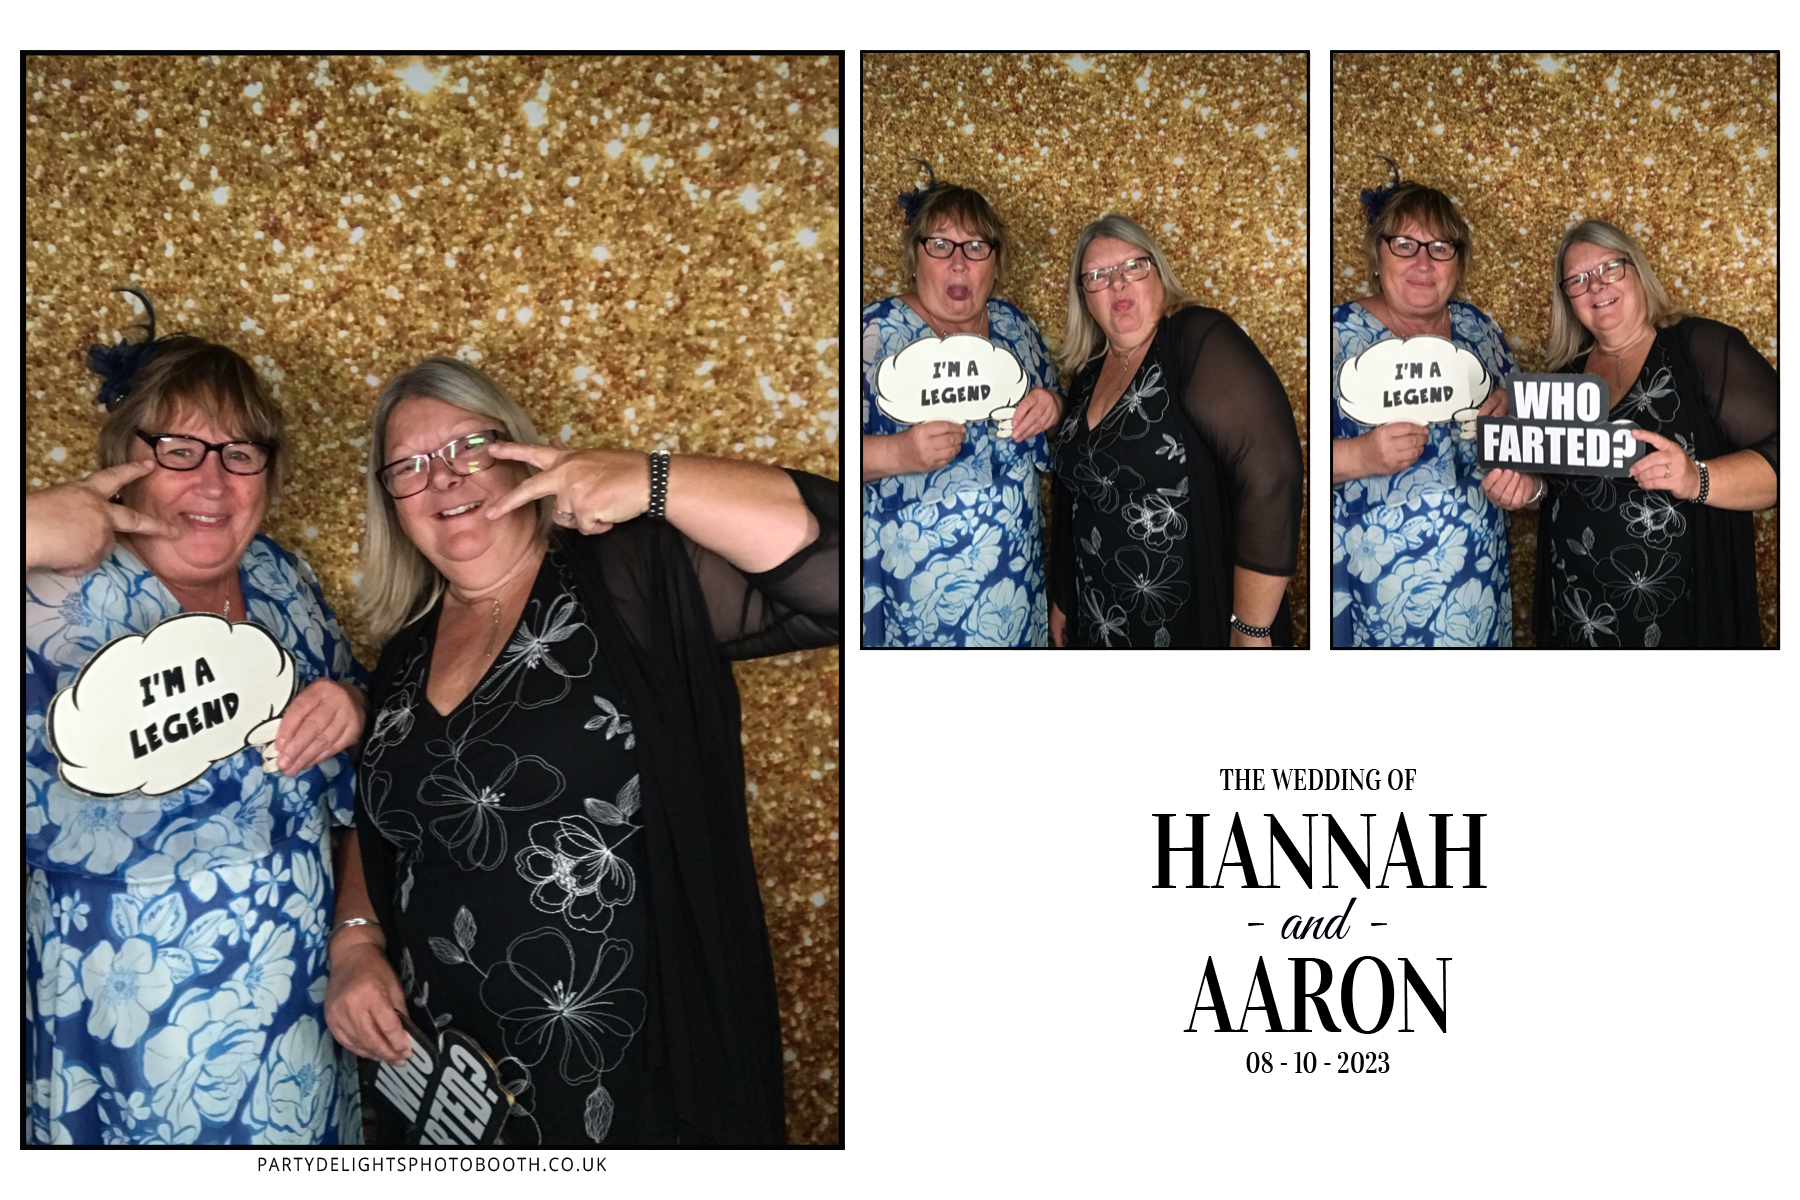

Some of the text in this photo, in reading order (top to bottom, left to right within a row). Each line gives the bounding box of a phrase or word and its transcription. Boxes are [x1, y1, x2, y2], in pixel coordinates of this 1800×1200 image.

[933, 360, 979, 379] I'M A
[1395, 361, 1442, 380] I'M A
[921, 384, 991, 406] LEGEND
[1383, 386, 1454, 408] LEGEND
[1514, 381, 1601, 422] WHO
[1483, 423, 1637, 469] FARTED?
[138, 657, 215, 707] I'M A
[129, 692, 239, 760] LEGEND
[374, 1030, 434, 1124] WHO
